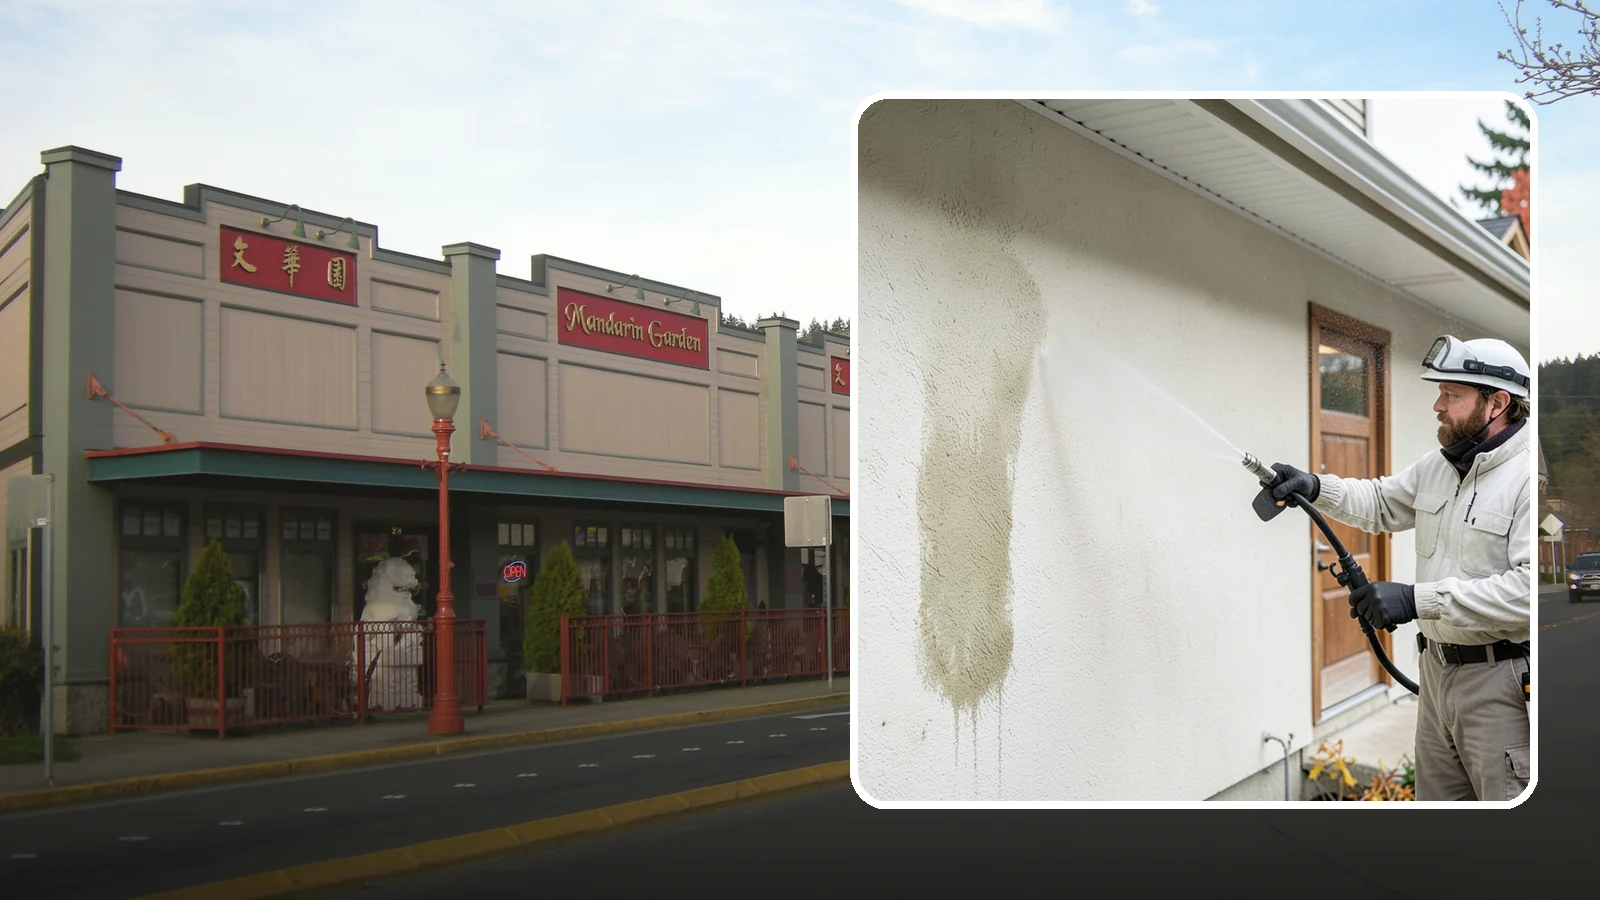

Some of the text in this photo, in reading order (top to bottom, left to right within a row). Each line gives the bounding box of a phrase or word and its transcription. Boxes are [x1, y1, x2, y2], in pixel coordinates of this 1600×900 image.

[231, 235, 346, 291] 文華園
[564, 302, 702, 352] Mandarin Garden
[835, 363, 846, 386] 文
[503, 565, 527, 578] OPEN
